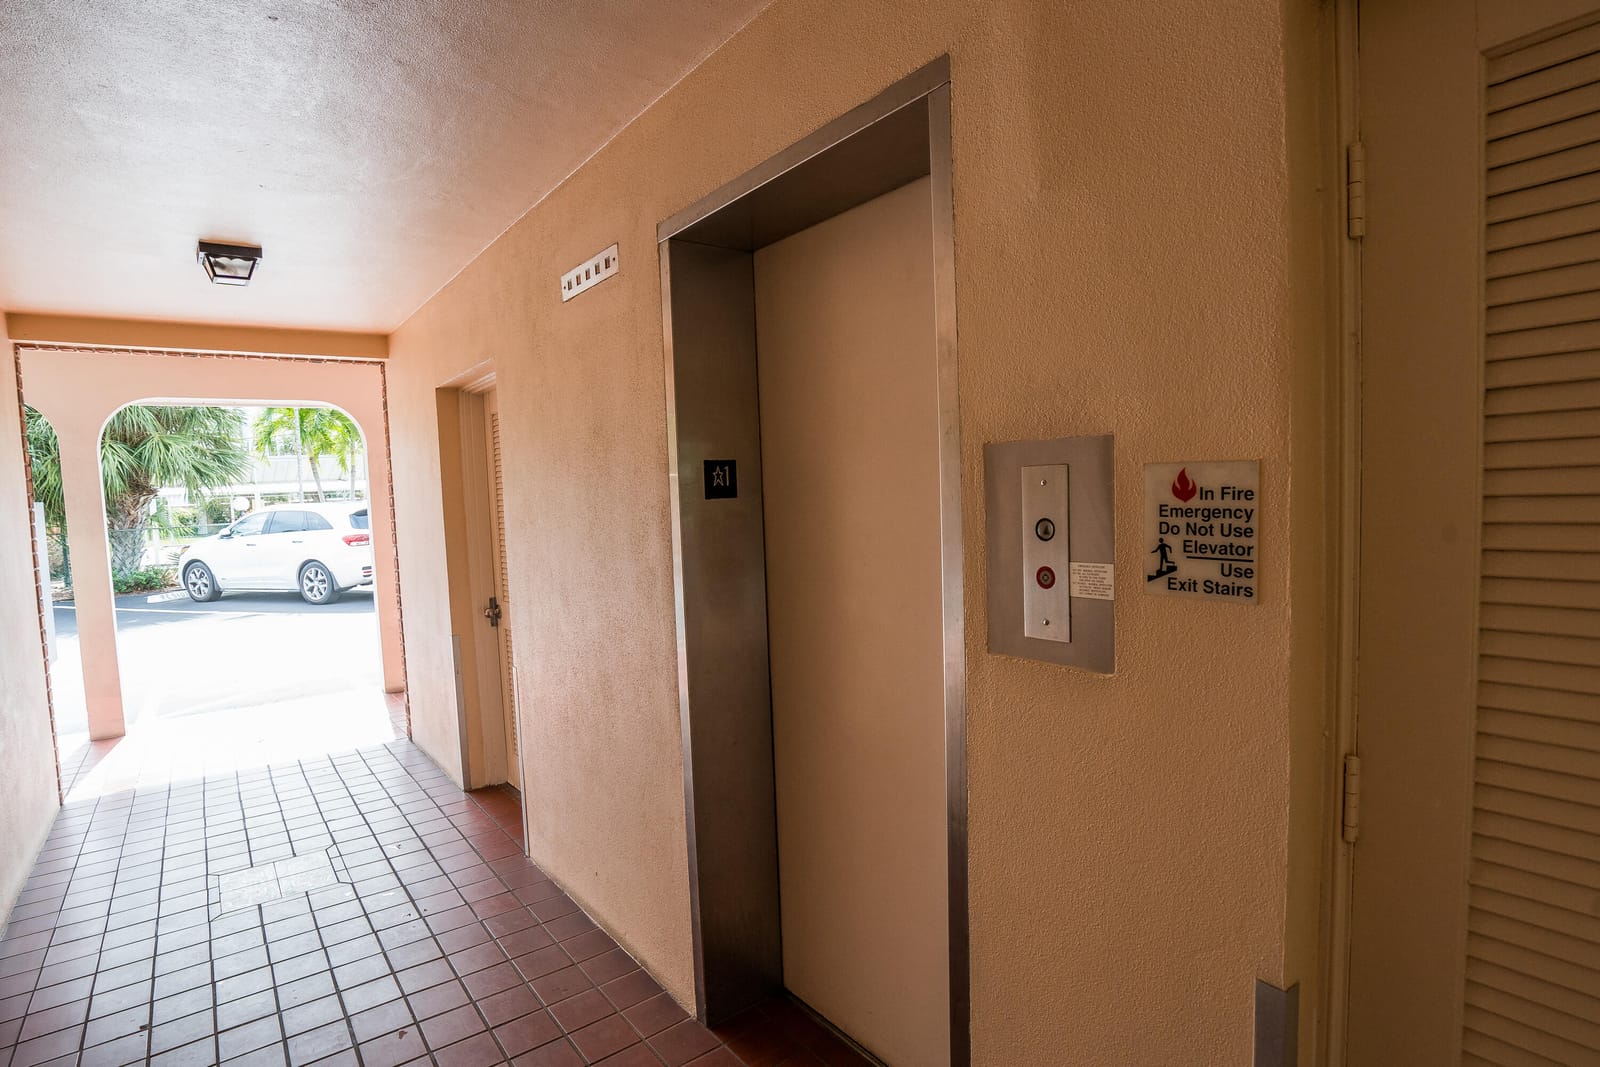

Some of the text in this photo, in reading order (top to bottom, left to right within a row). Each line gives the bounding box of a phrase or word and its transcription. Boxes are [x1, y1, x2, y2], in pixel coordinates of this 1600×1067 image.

[723, 465, 730, 487] 1
[1199, 486, 1255, 501] In Fire
[1159, 504, 1254, 523] Emergency
[1159, 521, 1254, 538] Do Not Use
[1183, 540, 1254, 557] Elevator
[1220, 563, 1254, 579] Use
[1167, 577, 1254, 598] Exit Stairs
